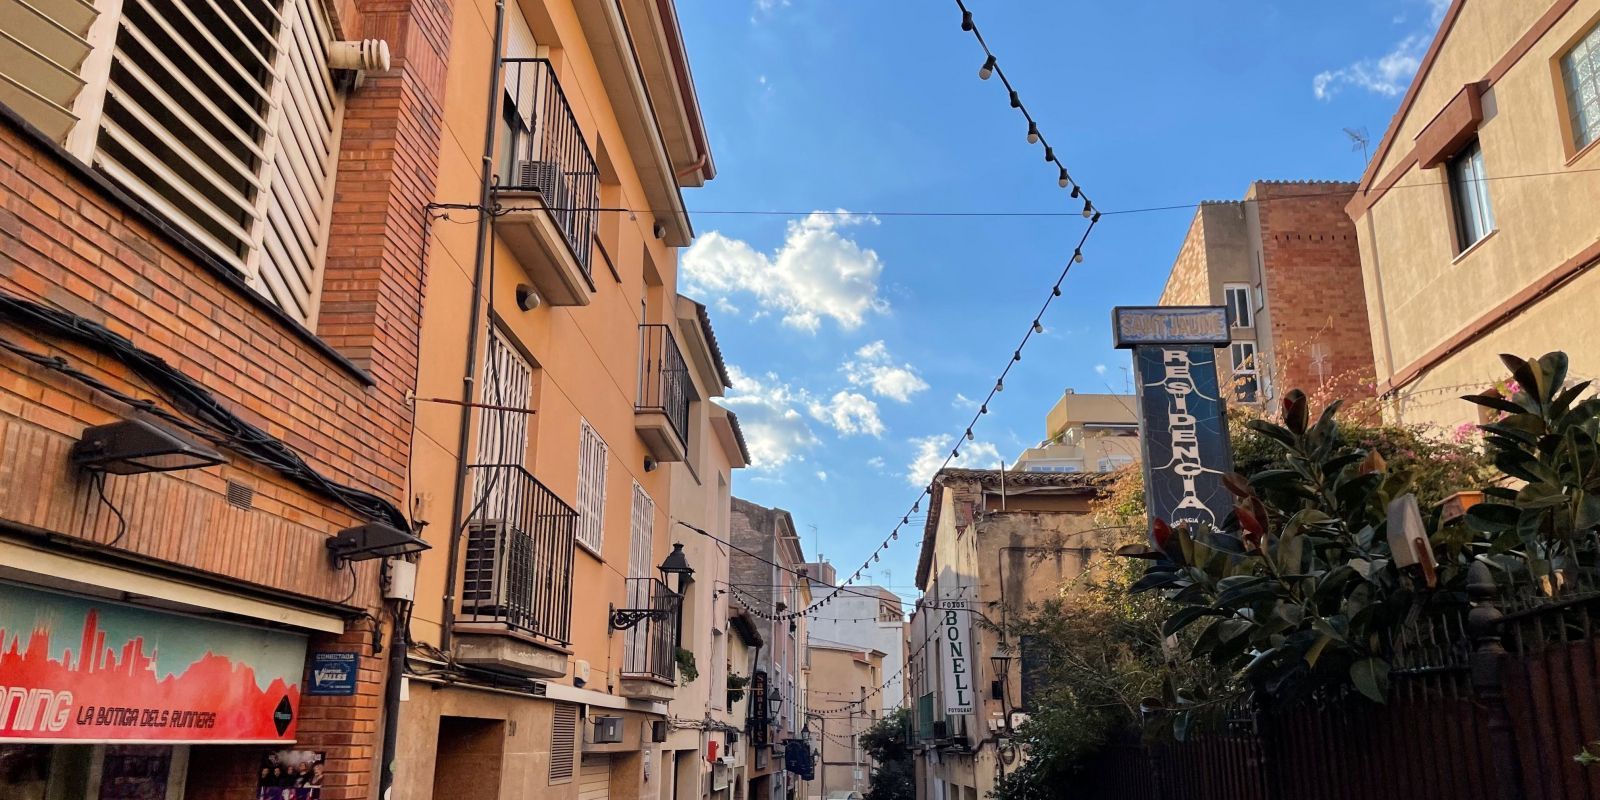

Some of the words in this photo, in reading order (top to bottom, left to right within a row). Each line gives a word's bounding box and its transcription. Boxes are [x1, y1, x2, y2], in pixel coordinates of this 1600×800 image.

[1163, 350, 1204, 508] RESIDENCIA
[945, 610, 970, 706] BONELL
[0, 685, 73, 732] NING
[77, 706, 95, 725] LA
[95, 706, 139, 727] BOTIGA
[140, 709, 169, 728] DELS
[169, 711, 216, 729] RUNNERS
